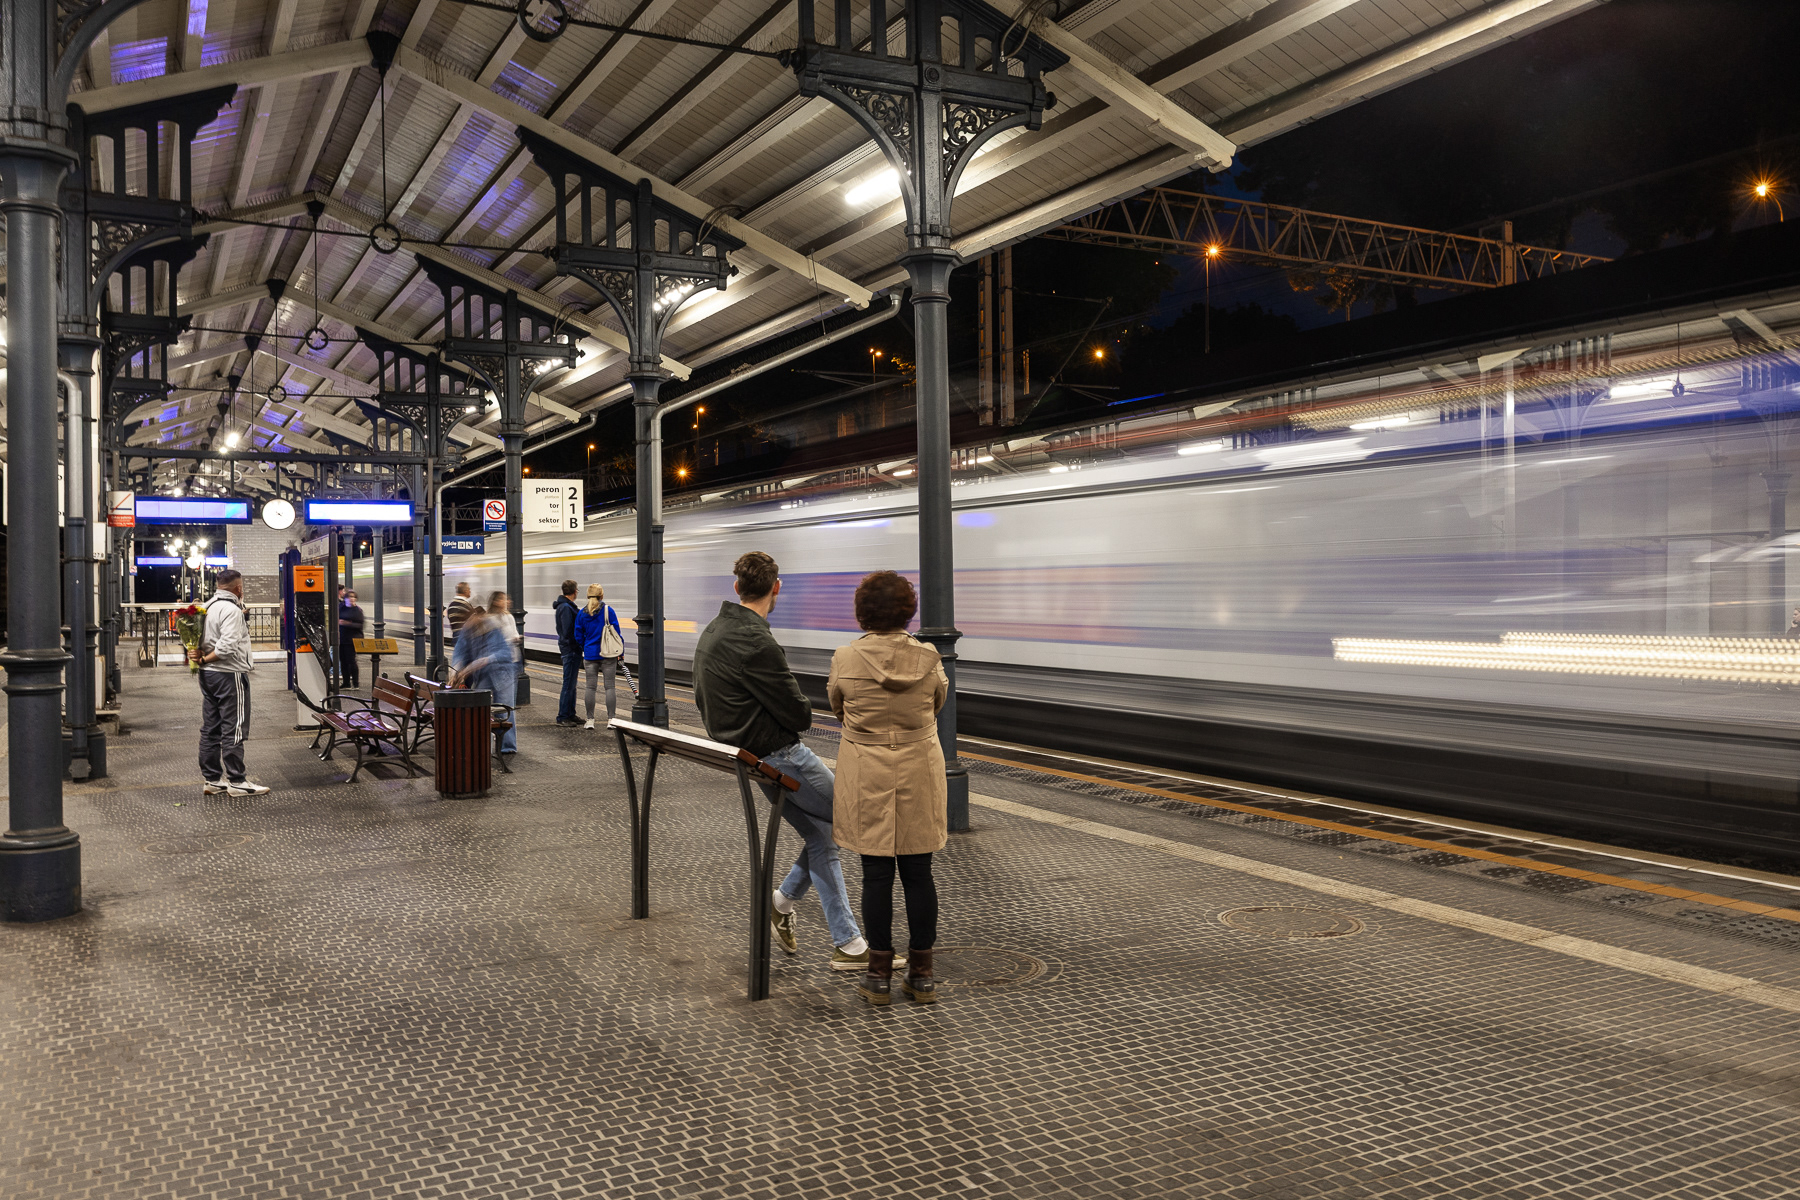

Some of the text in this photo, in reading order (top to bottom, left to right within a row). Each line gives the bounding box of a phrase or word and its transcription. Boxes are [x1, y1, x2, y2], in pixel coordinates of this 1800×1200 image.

[535, 486, 578, 500] peron 2
[569, 502, 576, 515] 1
[569, 517, 578, 529] B
